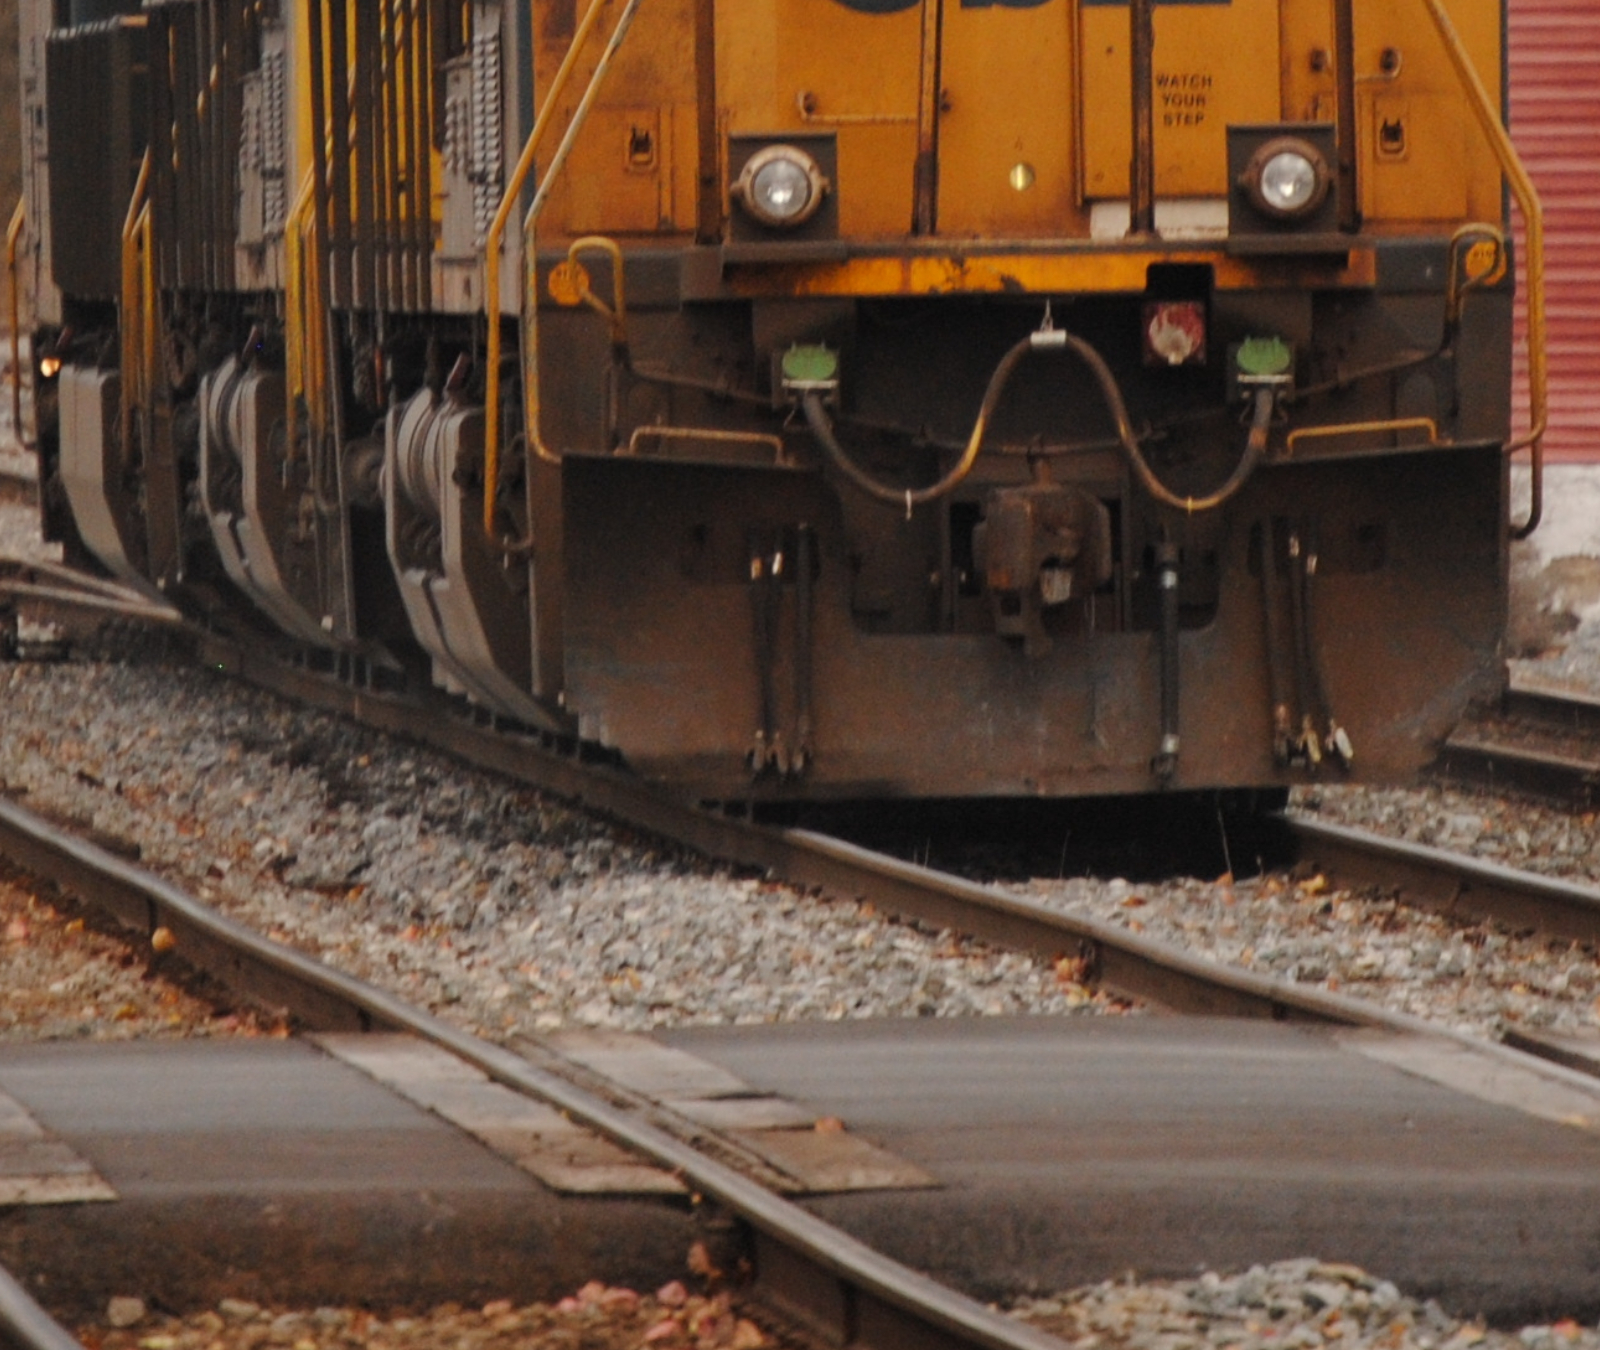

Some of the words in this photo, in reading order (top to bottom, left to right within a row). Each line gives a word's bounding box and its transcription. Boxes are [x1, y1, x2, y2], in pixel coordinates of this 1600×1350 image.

[1157, 74, 1212, 88] WATCH
[1163, 94, 1206, 107] YOUR
[1164, 112, 1204, 126] STEP
